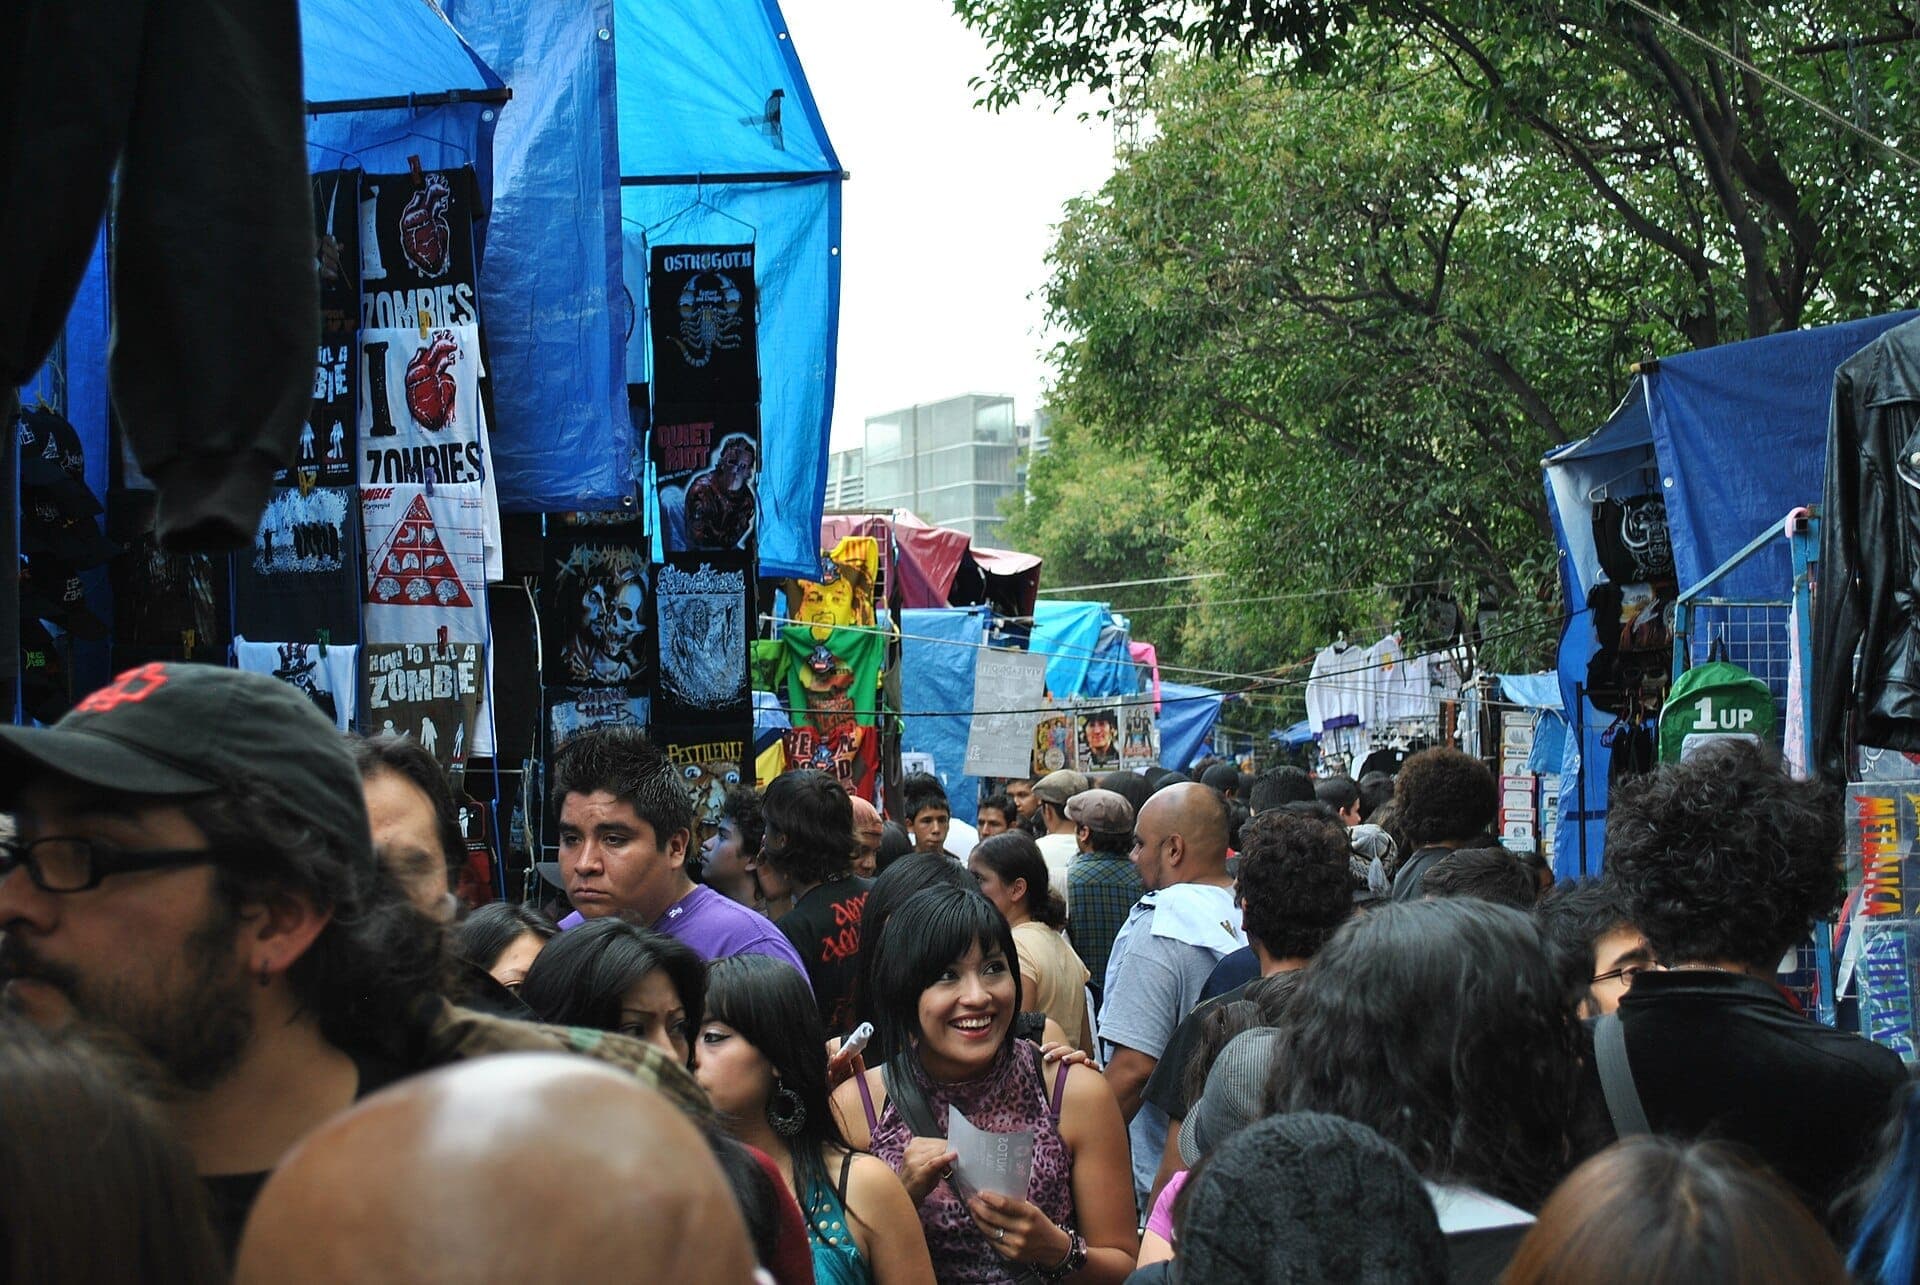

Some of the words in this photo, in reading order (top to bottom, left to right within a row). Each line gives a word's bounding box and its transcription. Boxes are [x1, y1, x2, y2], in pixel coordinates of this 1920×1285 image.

[664, 250, 752, 272] OSTROGOTH
[363, 283, 477, 328] ZOMBIES
[311, 363, 348, 402] BIE
[365, 342, 396, 436] I
[657, 423, 714, 449] QUIET
[367, 441, 485, 484] ZOMBIES
[665, 446, 710, 471] RIOT
[370, 650, 403, 672] HOW
[405, 644, 423, 664] TO
[463, 644, 476, 661] A
[369, 662, 475, 709] ZOMBIE
[1693, 697, 1717, 729] 1
[1720, 709, 1753, 729] UP
[1854, 796, 1902, 916] METALLICA
